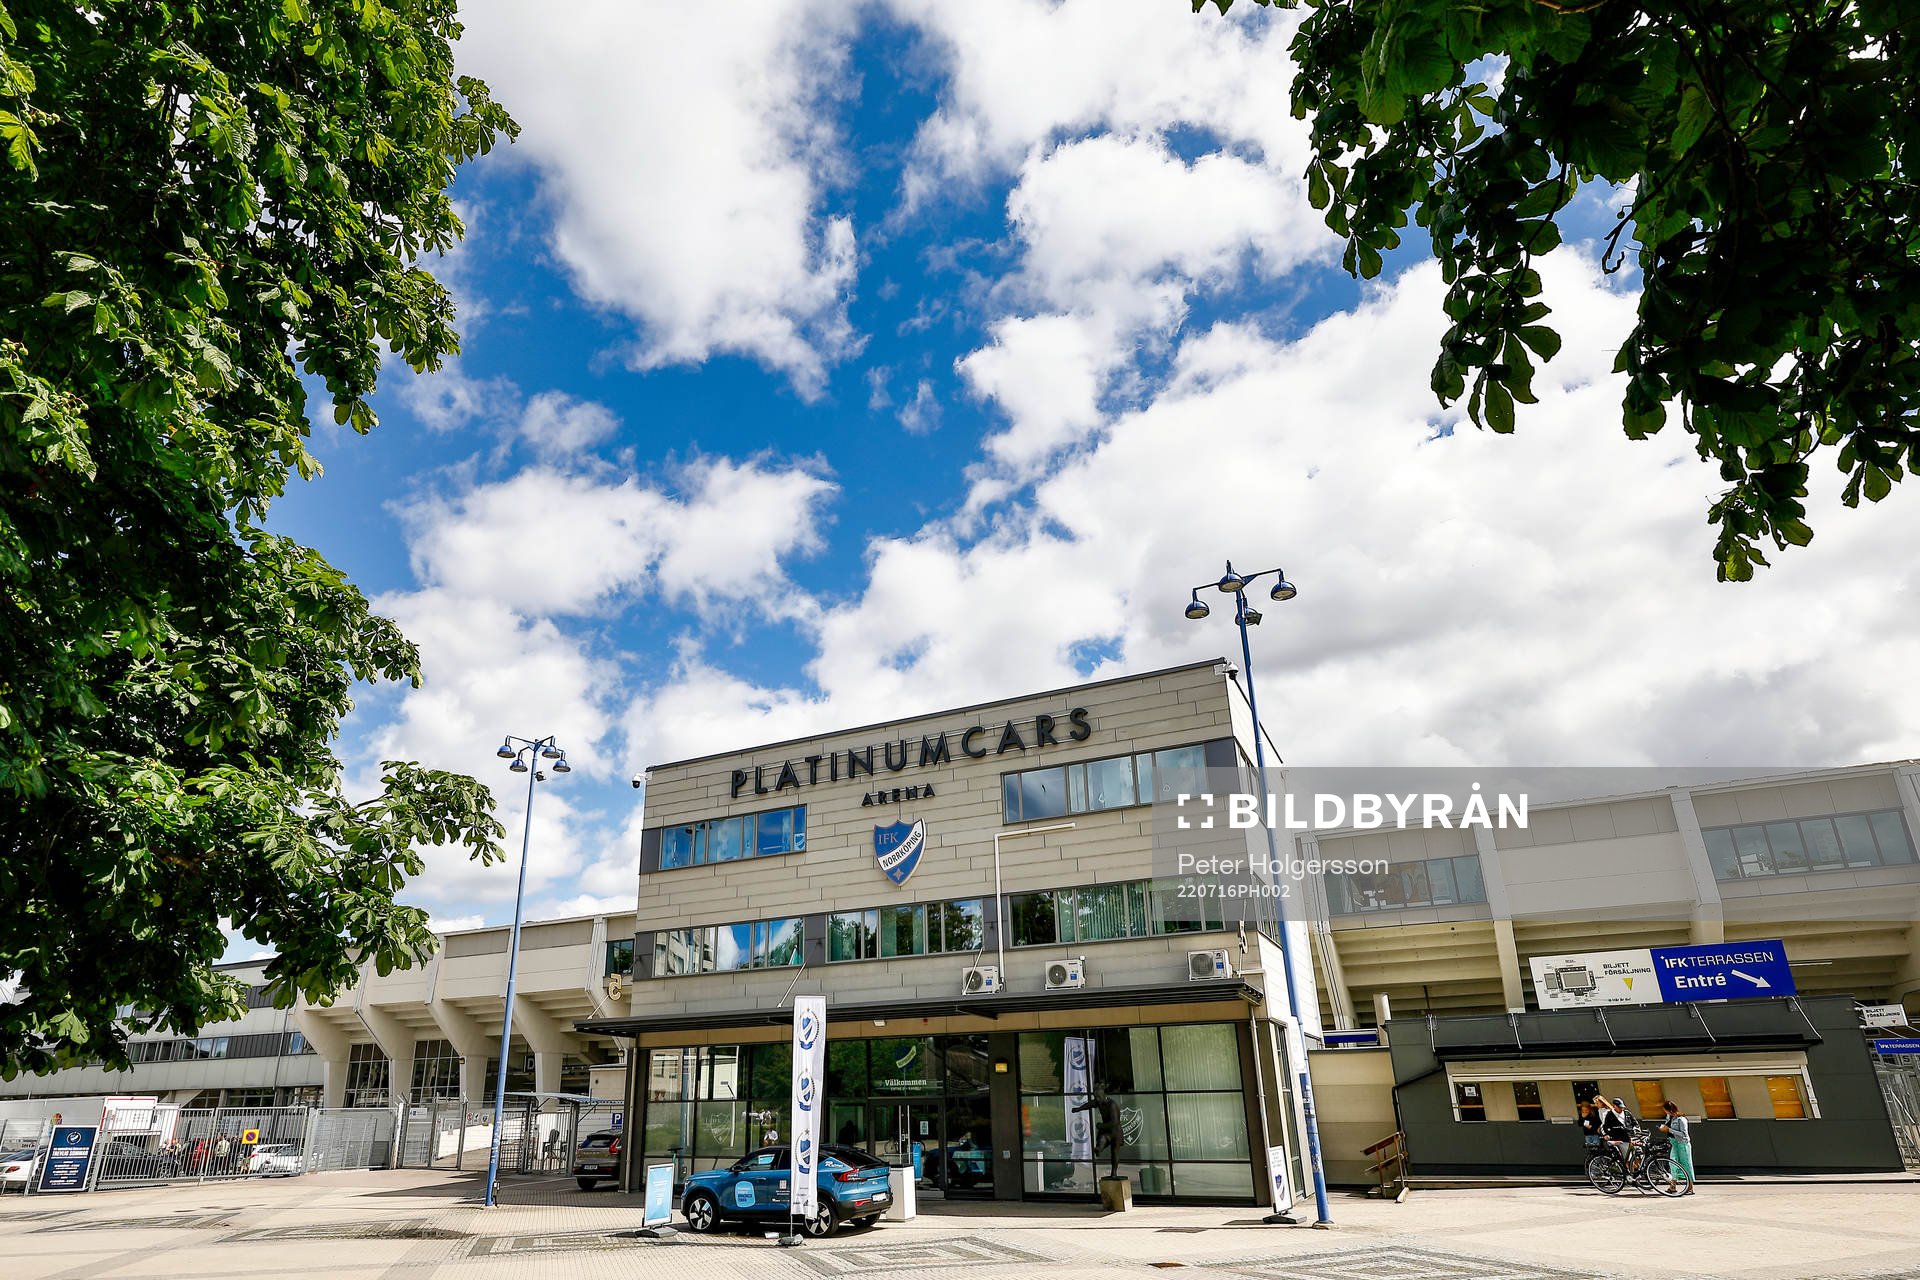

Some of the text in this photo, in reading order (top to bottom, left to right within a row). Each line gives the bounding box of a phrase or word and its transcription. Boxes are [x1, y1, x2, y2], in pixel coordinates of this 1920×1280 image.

[861, 783, 936, 806] ARENA
[878, 831, 899, 845] IFK
[882, 830, 922, 868] NORRKÖPING
[1604, 967, 1652, 976] FÖRSÄLJNING
[1674, 973, 1727, 989] Entré
[614, 1113, 621, 1124] P
